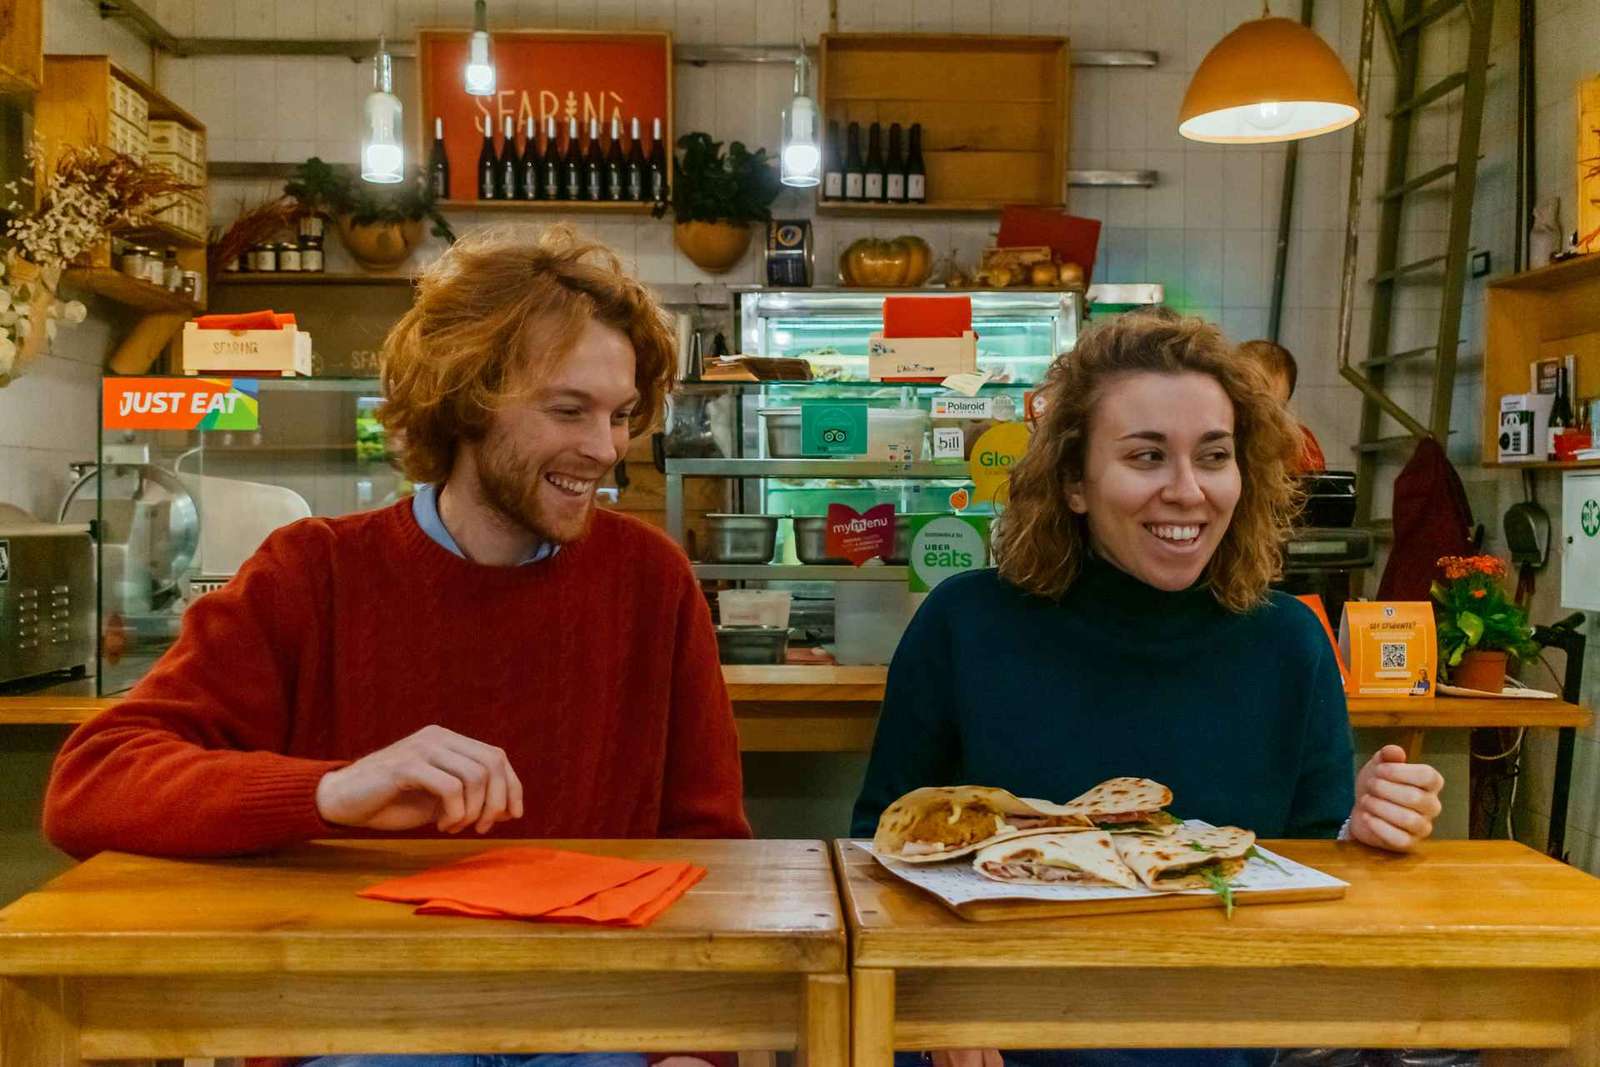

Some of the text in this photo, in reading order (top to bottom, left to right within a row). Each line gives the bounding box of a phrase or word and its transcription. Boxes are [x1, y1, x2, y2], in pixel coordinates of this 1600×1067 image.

[120, 391, 241, 416] JUST EAT
[947, 402, 985, 411] Polaroid
[980, 451, 1014, 467] Glo
[924, 543, 950, 551] UBER
[924, 549, 972, 567] eats
